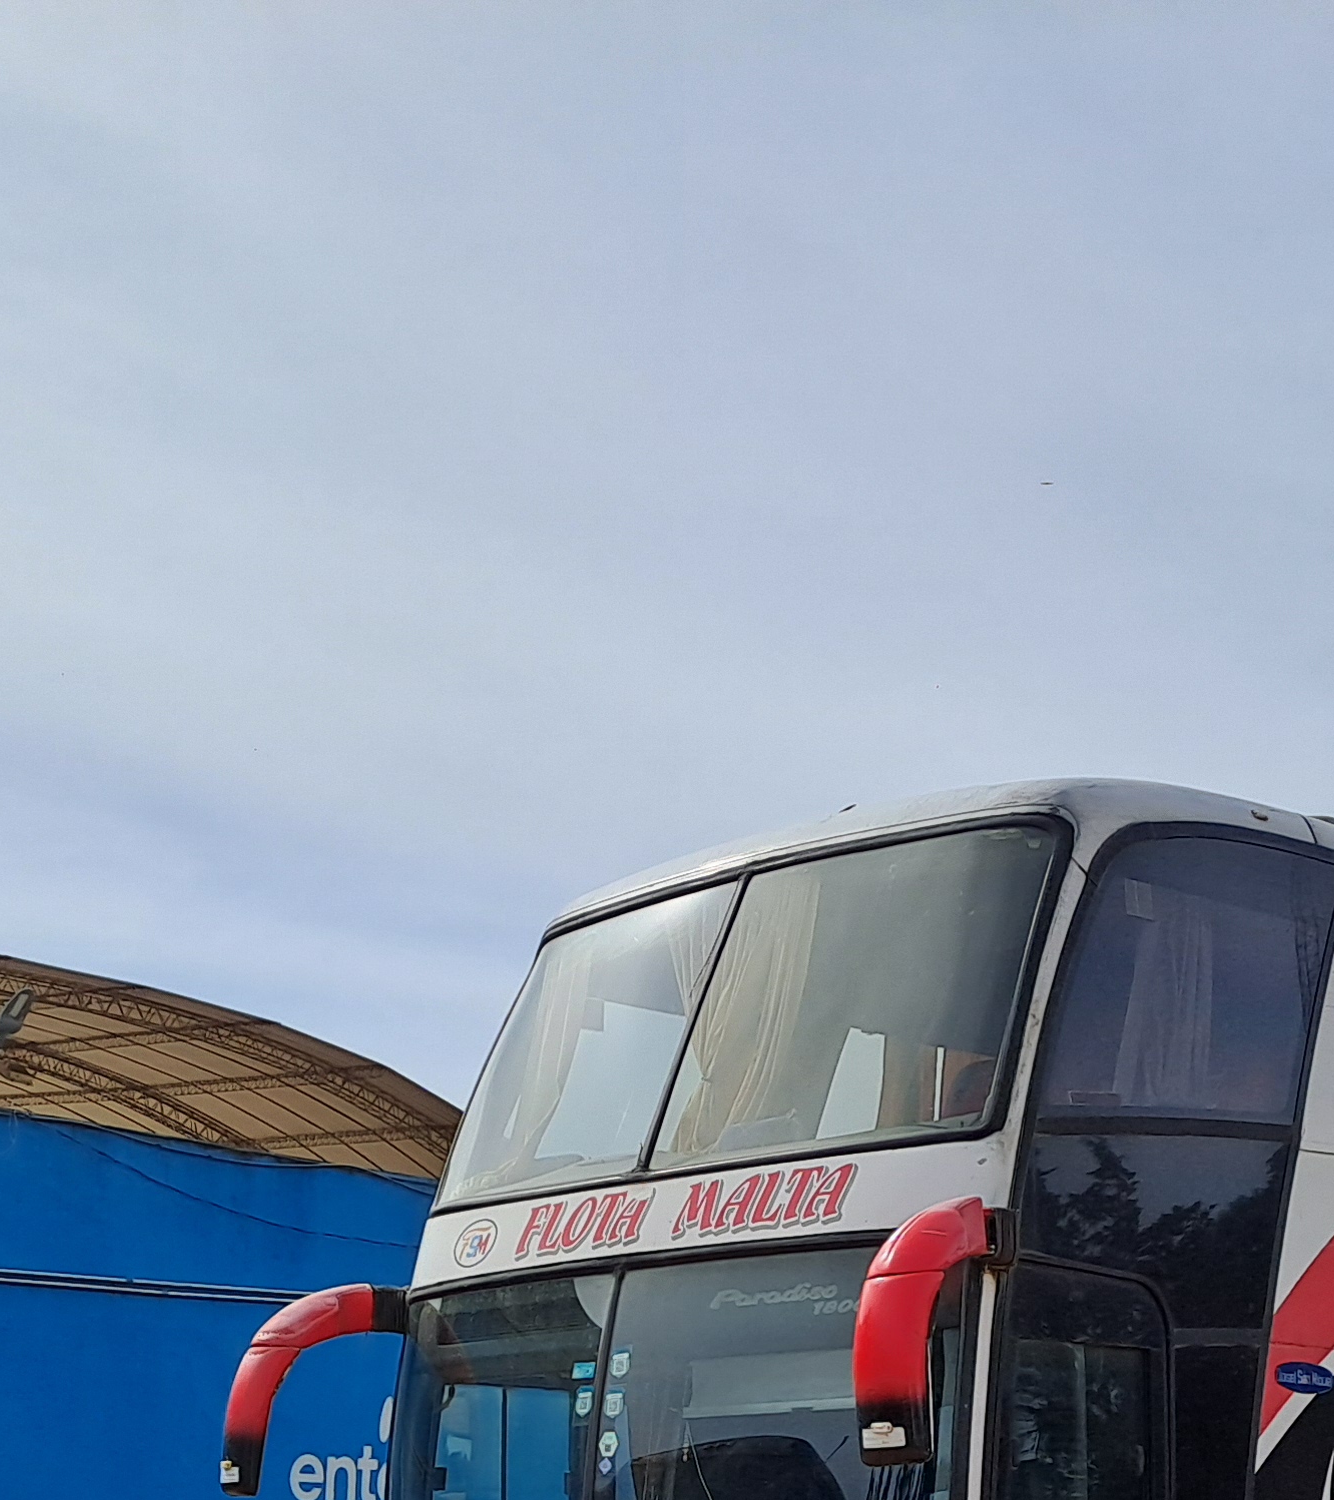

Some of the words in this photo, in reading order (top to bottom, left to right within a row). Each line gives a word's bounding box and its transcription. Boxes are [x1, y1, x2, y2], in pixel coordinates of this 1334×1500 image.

[515, 1187, 656, 1261] FLOTA
[671, 1162, 858, 1241] MALTA
[710, 1282, 838, 1310] Paradiso
